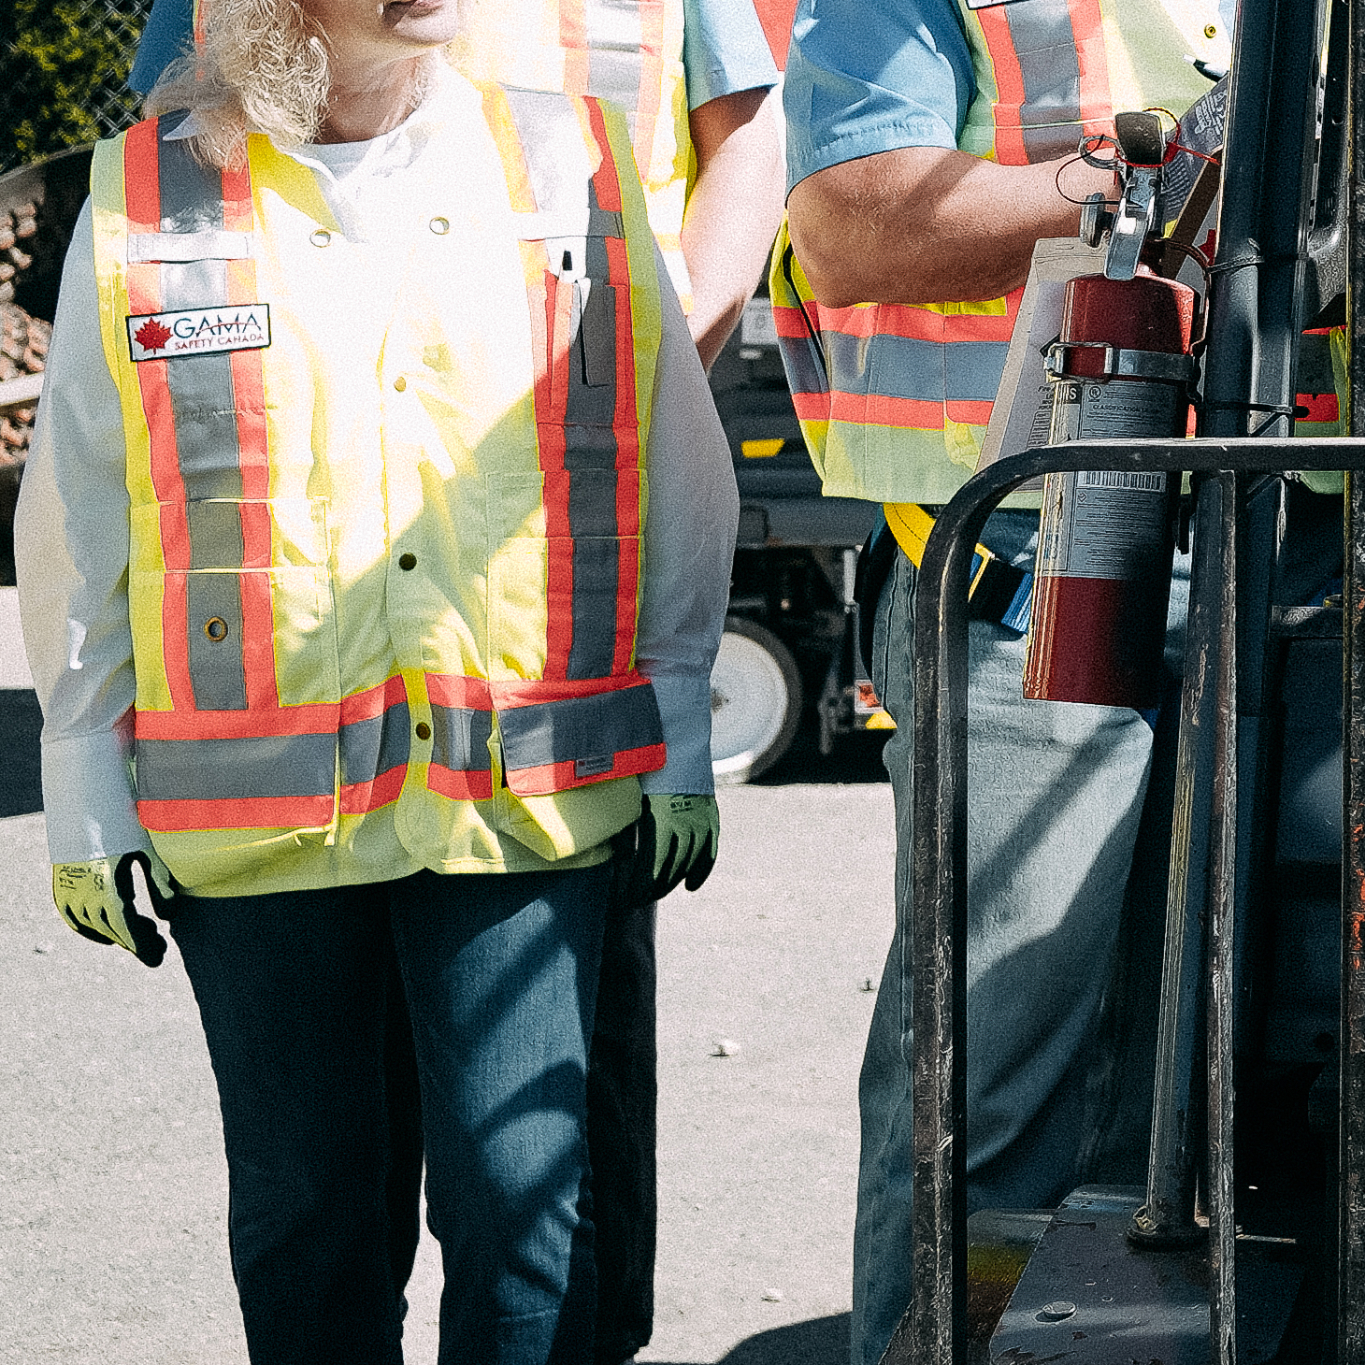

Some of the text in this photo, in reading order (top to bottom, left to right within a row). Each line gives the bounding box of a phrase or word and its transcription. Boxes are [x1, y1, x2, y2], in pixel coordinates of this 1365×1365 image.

[173, 312, 262, 339] GAMA
[174, 333, 264, 351] SAFETY CANADA
